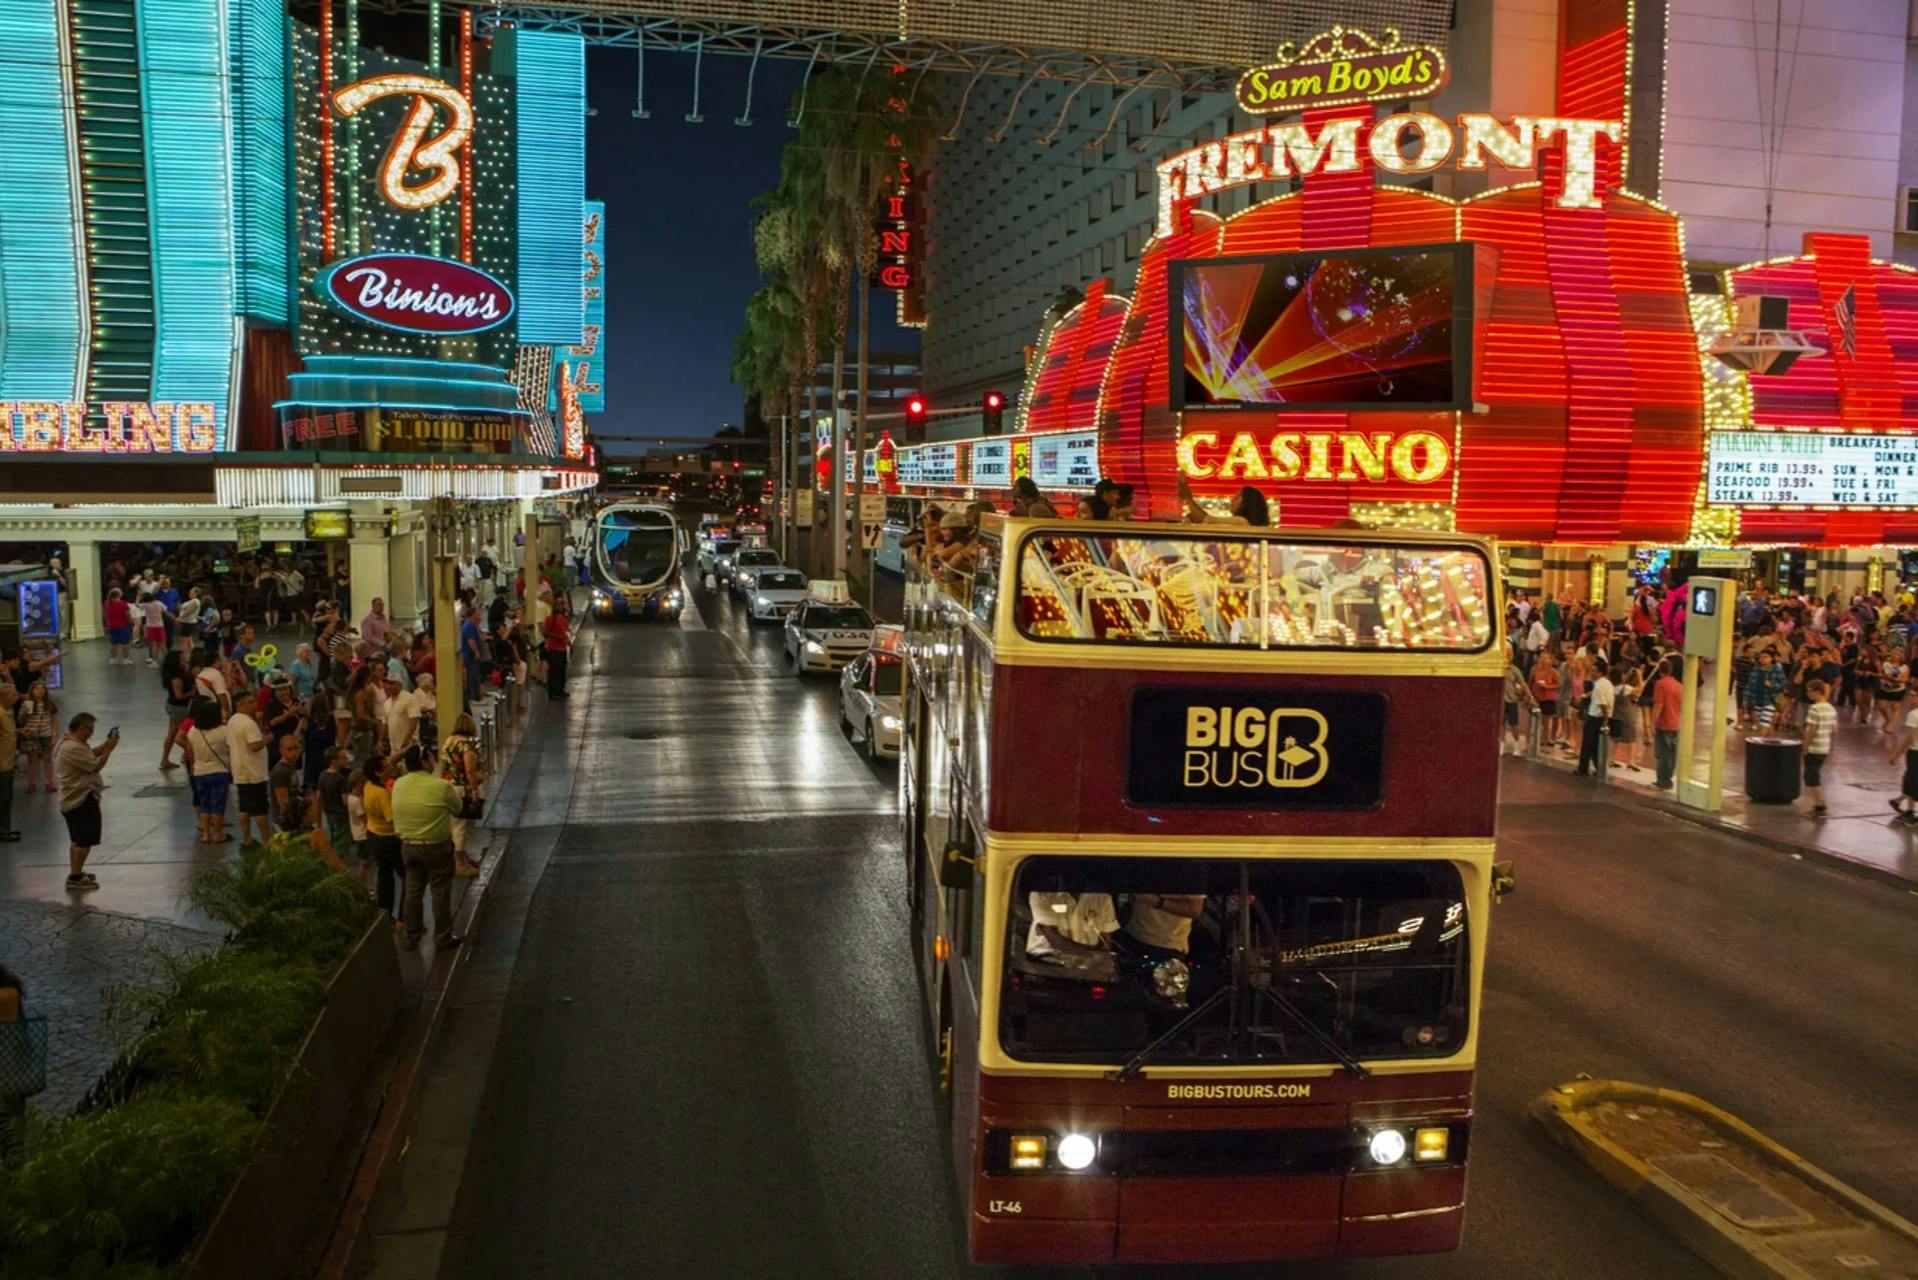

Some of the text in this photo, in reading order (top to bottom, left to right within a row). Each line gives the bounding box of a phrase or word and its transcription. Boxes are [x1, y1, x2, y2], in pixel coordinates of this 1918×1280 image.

[1248, 51, 1432, 104] Sam Boyd's
[333, 74, 473, 210] B
[1156, 113, 1622, 239] FREMONT
[345, 267, 501, 320] Binion's
[392, 410, 418, 420] Take
[421, 411, 446, 422] Your
[282, 412, 358, 442] FREE
[1829, 437, 1898, 449] BREAKFAST
[1176, 430, 1452, 483] CASINO
[1875, 452, 1917, 463] DINNER
[1716, 462, 1752, 473] PRIME
[1759, 463, 1779, 474] RIB
[1833, 465, 1857, 475] SUN
[1875, 466, 1899, 477] MON
[1715, 476, 1770, 487] SEAFOOD
[1833, 478, 1855, 489] TUE
[1876, 478, 1895, 489] FRI
[1715, 490, 1754, 501] STEAK
[1832, 492, 1856, 503] WED
[1878, 492, 1898, 503] SAT
[1185, 706, 1267, 749] BIG
[1184, 751, 1264, 788] BUS
[1167, 1083, 1311, 1099] BIGBUSTOURS.COM
[989, 1200, 1022, 1214] LT-46
